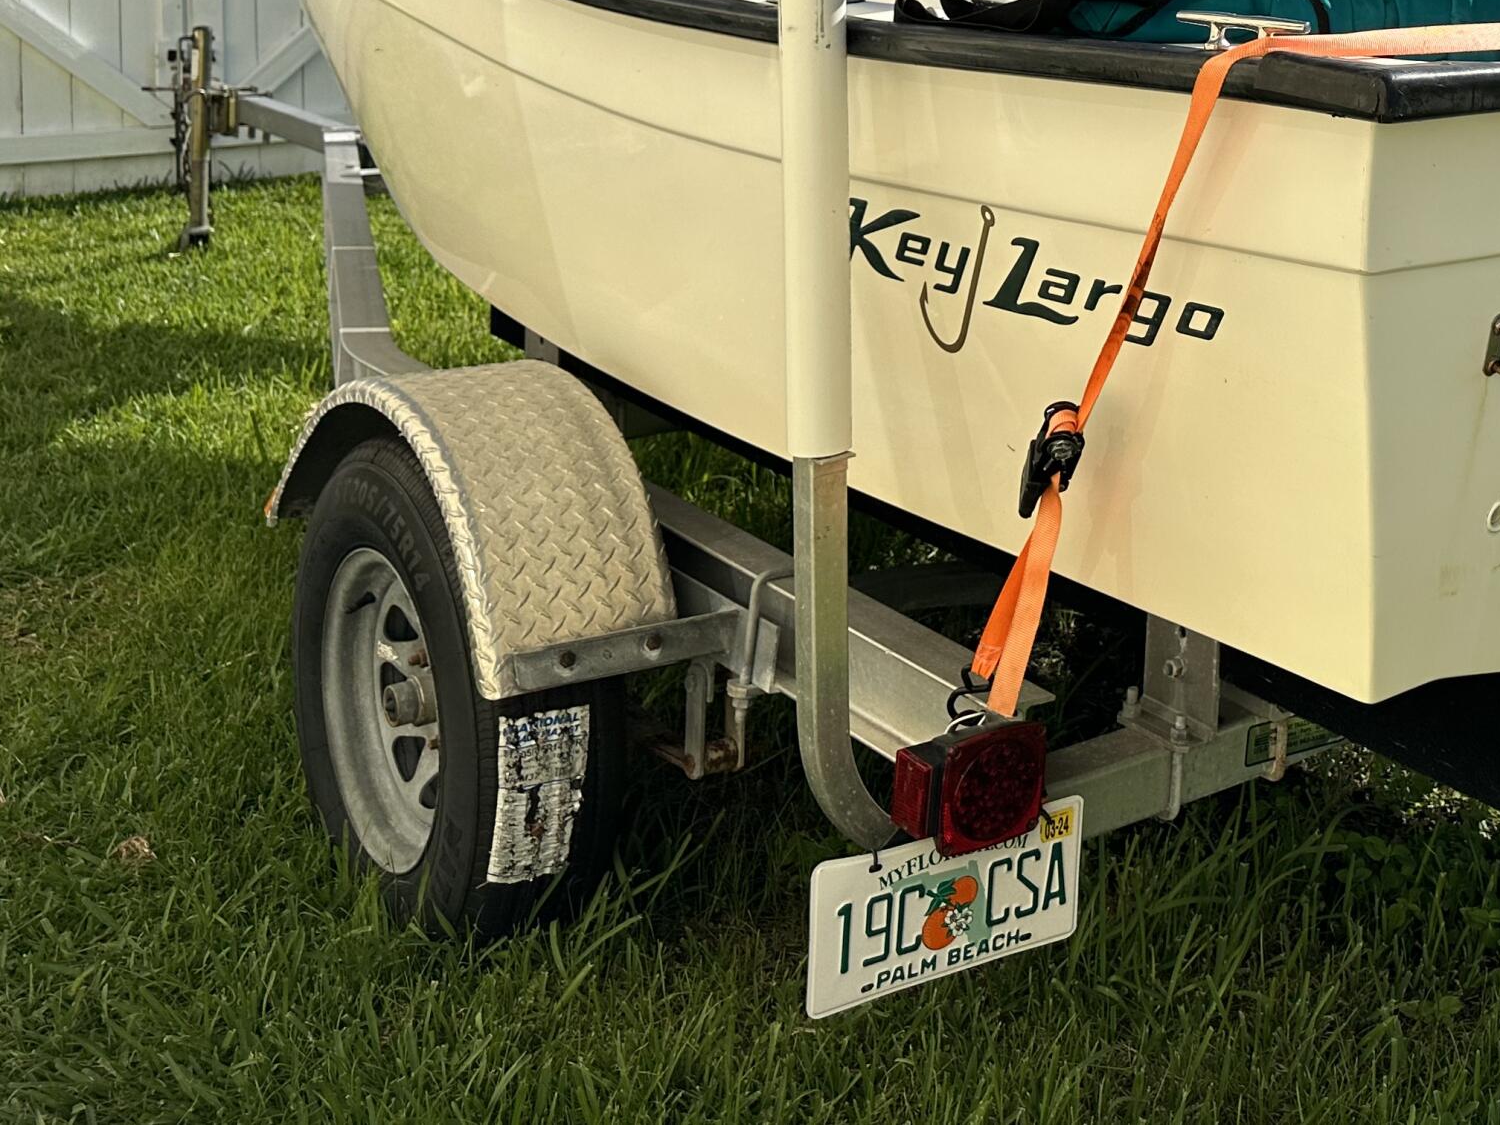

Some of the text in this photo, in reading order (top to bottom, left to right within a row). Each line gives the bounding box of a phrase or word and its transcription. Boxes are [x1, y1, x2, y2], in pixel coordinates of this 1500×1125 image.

[849, 197, 1224, 347] Key Largo
[1044, 814, 1070, 839] 03-24
[876, 929, 1020, 989] PALM BEACH
